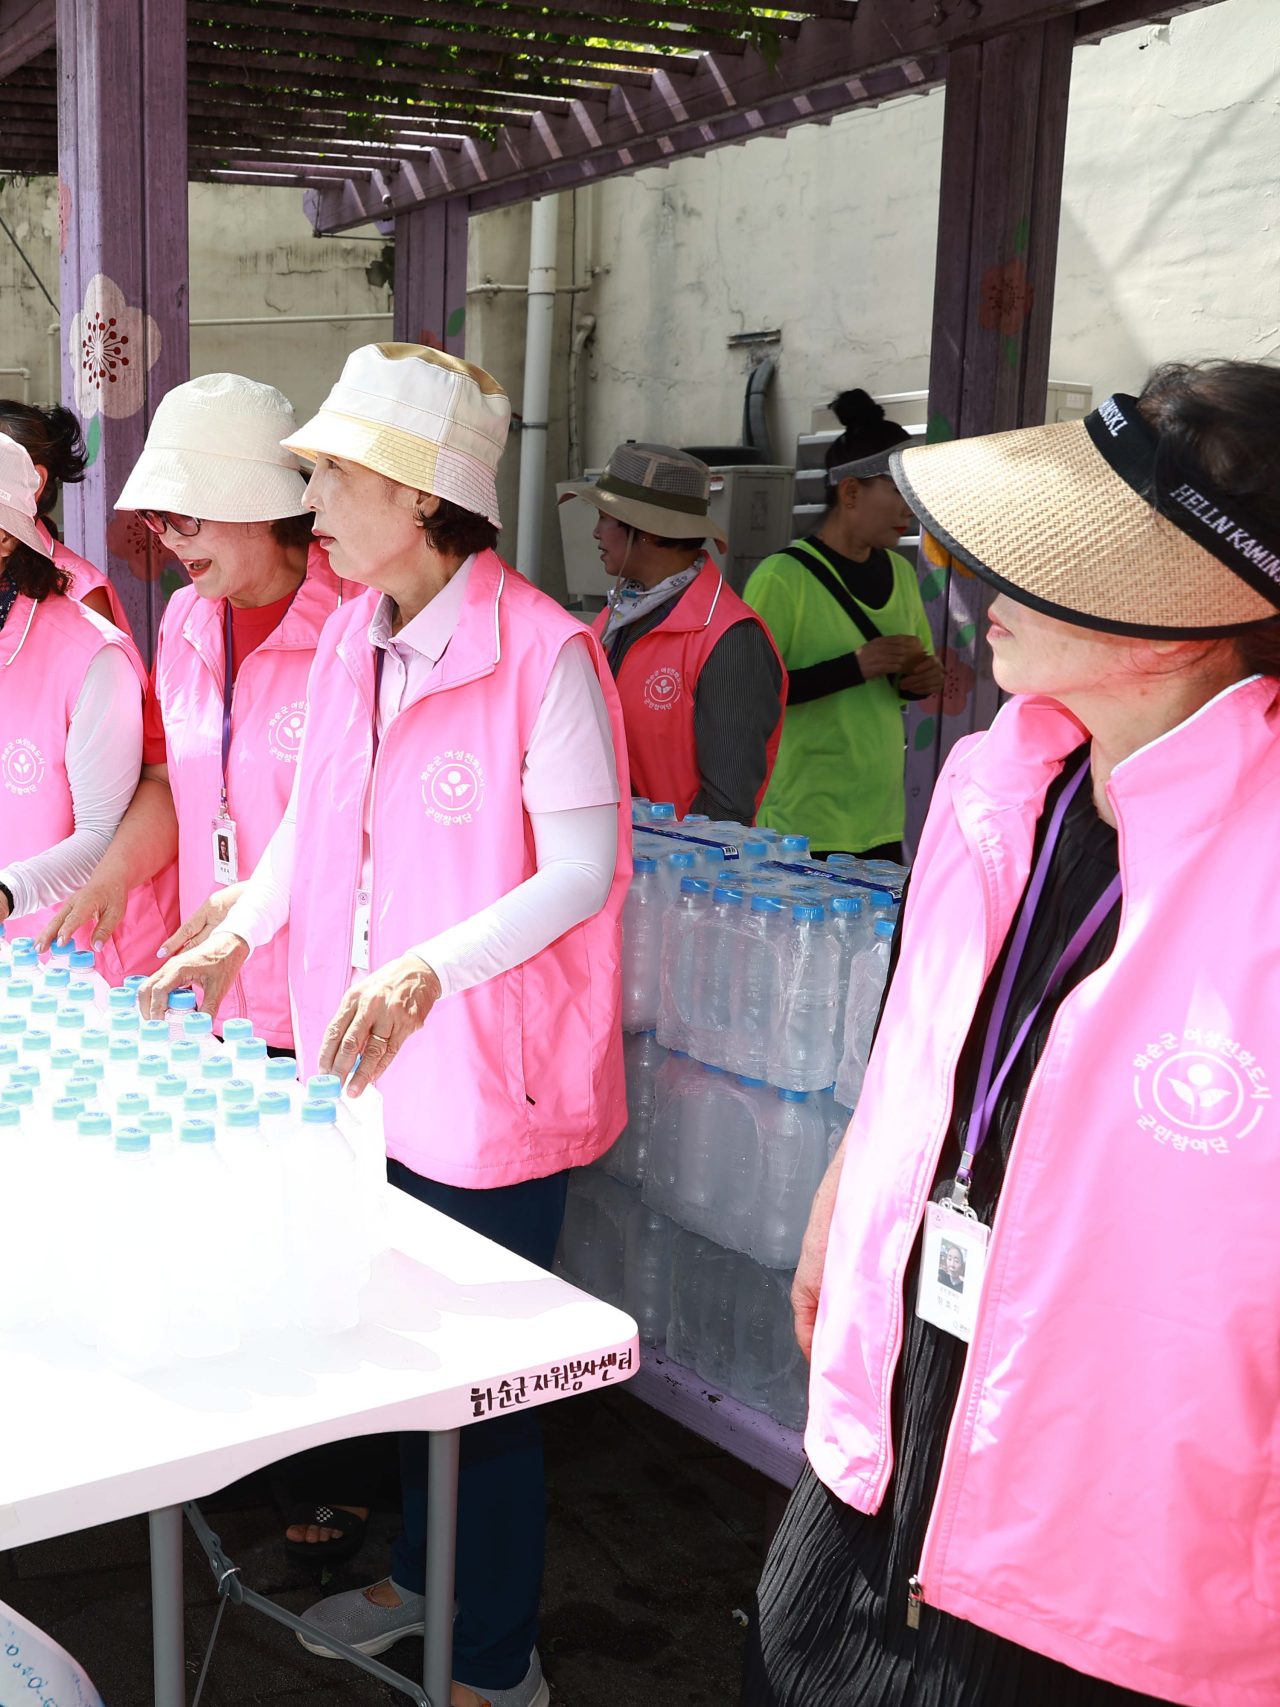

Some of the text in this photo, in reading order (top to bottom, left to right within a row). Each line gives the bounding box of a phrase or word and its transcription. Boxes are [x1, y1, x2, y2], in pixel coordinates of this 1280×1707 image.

[420, 755, 442, 782] 화순군
[424, 806, 472, 826] 군민참여단
[1132, 1027, 1273, 1099] 화순군 여성친화도시
[1136, 1113, 1231, 1155] 군민참여단
